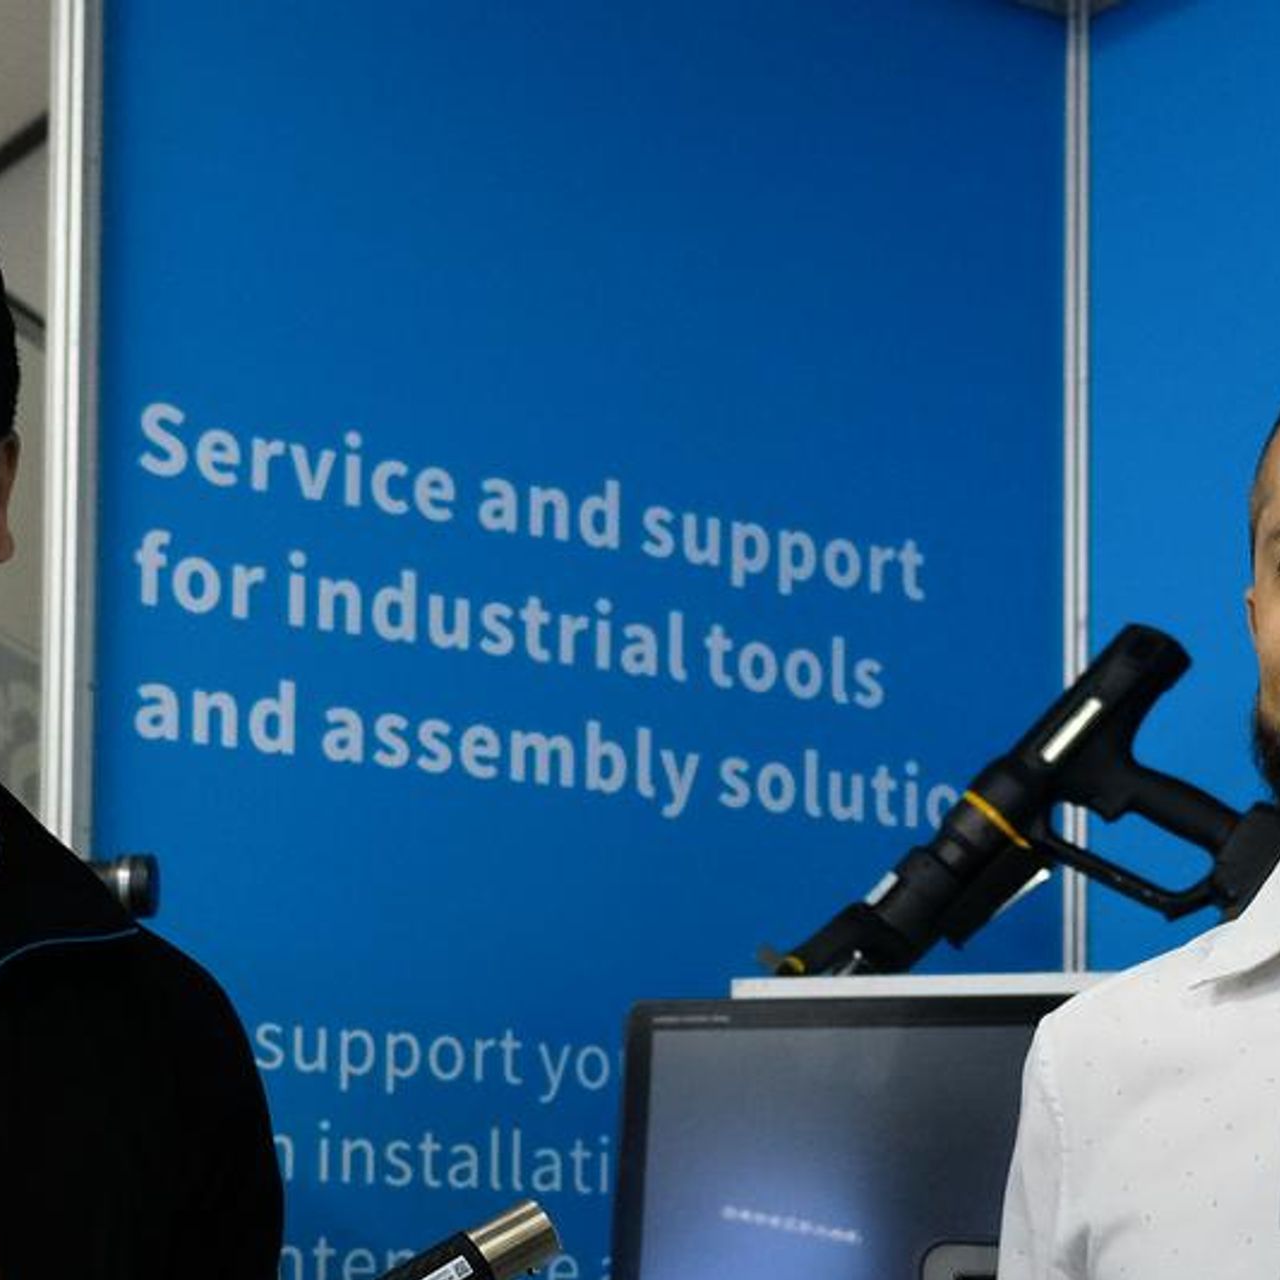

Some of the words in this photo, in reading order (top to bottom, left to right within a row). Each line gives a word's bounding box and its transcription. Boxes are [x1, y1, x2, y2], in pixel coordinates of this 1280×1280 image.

[138, 402, 457, 522] Service
[477, 478, 622, 550] and
[640, 503, 926, 602] support
[134, 530, 267, 619] for
[287, 551, 687, 683] industrial
[705, 624, 886, 710] tools
[133, 680, 297, 756] and
[322, 703, 700, 820] assembly
[254, 1020, 524, 1096] support
